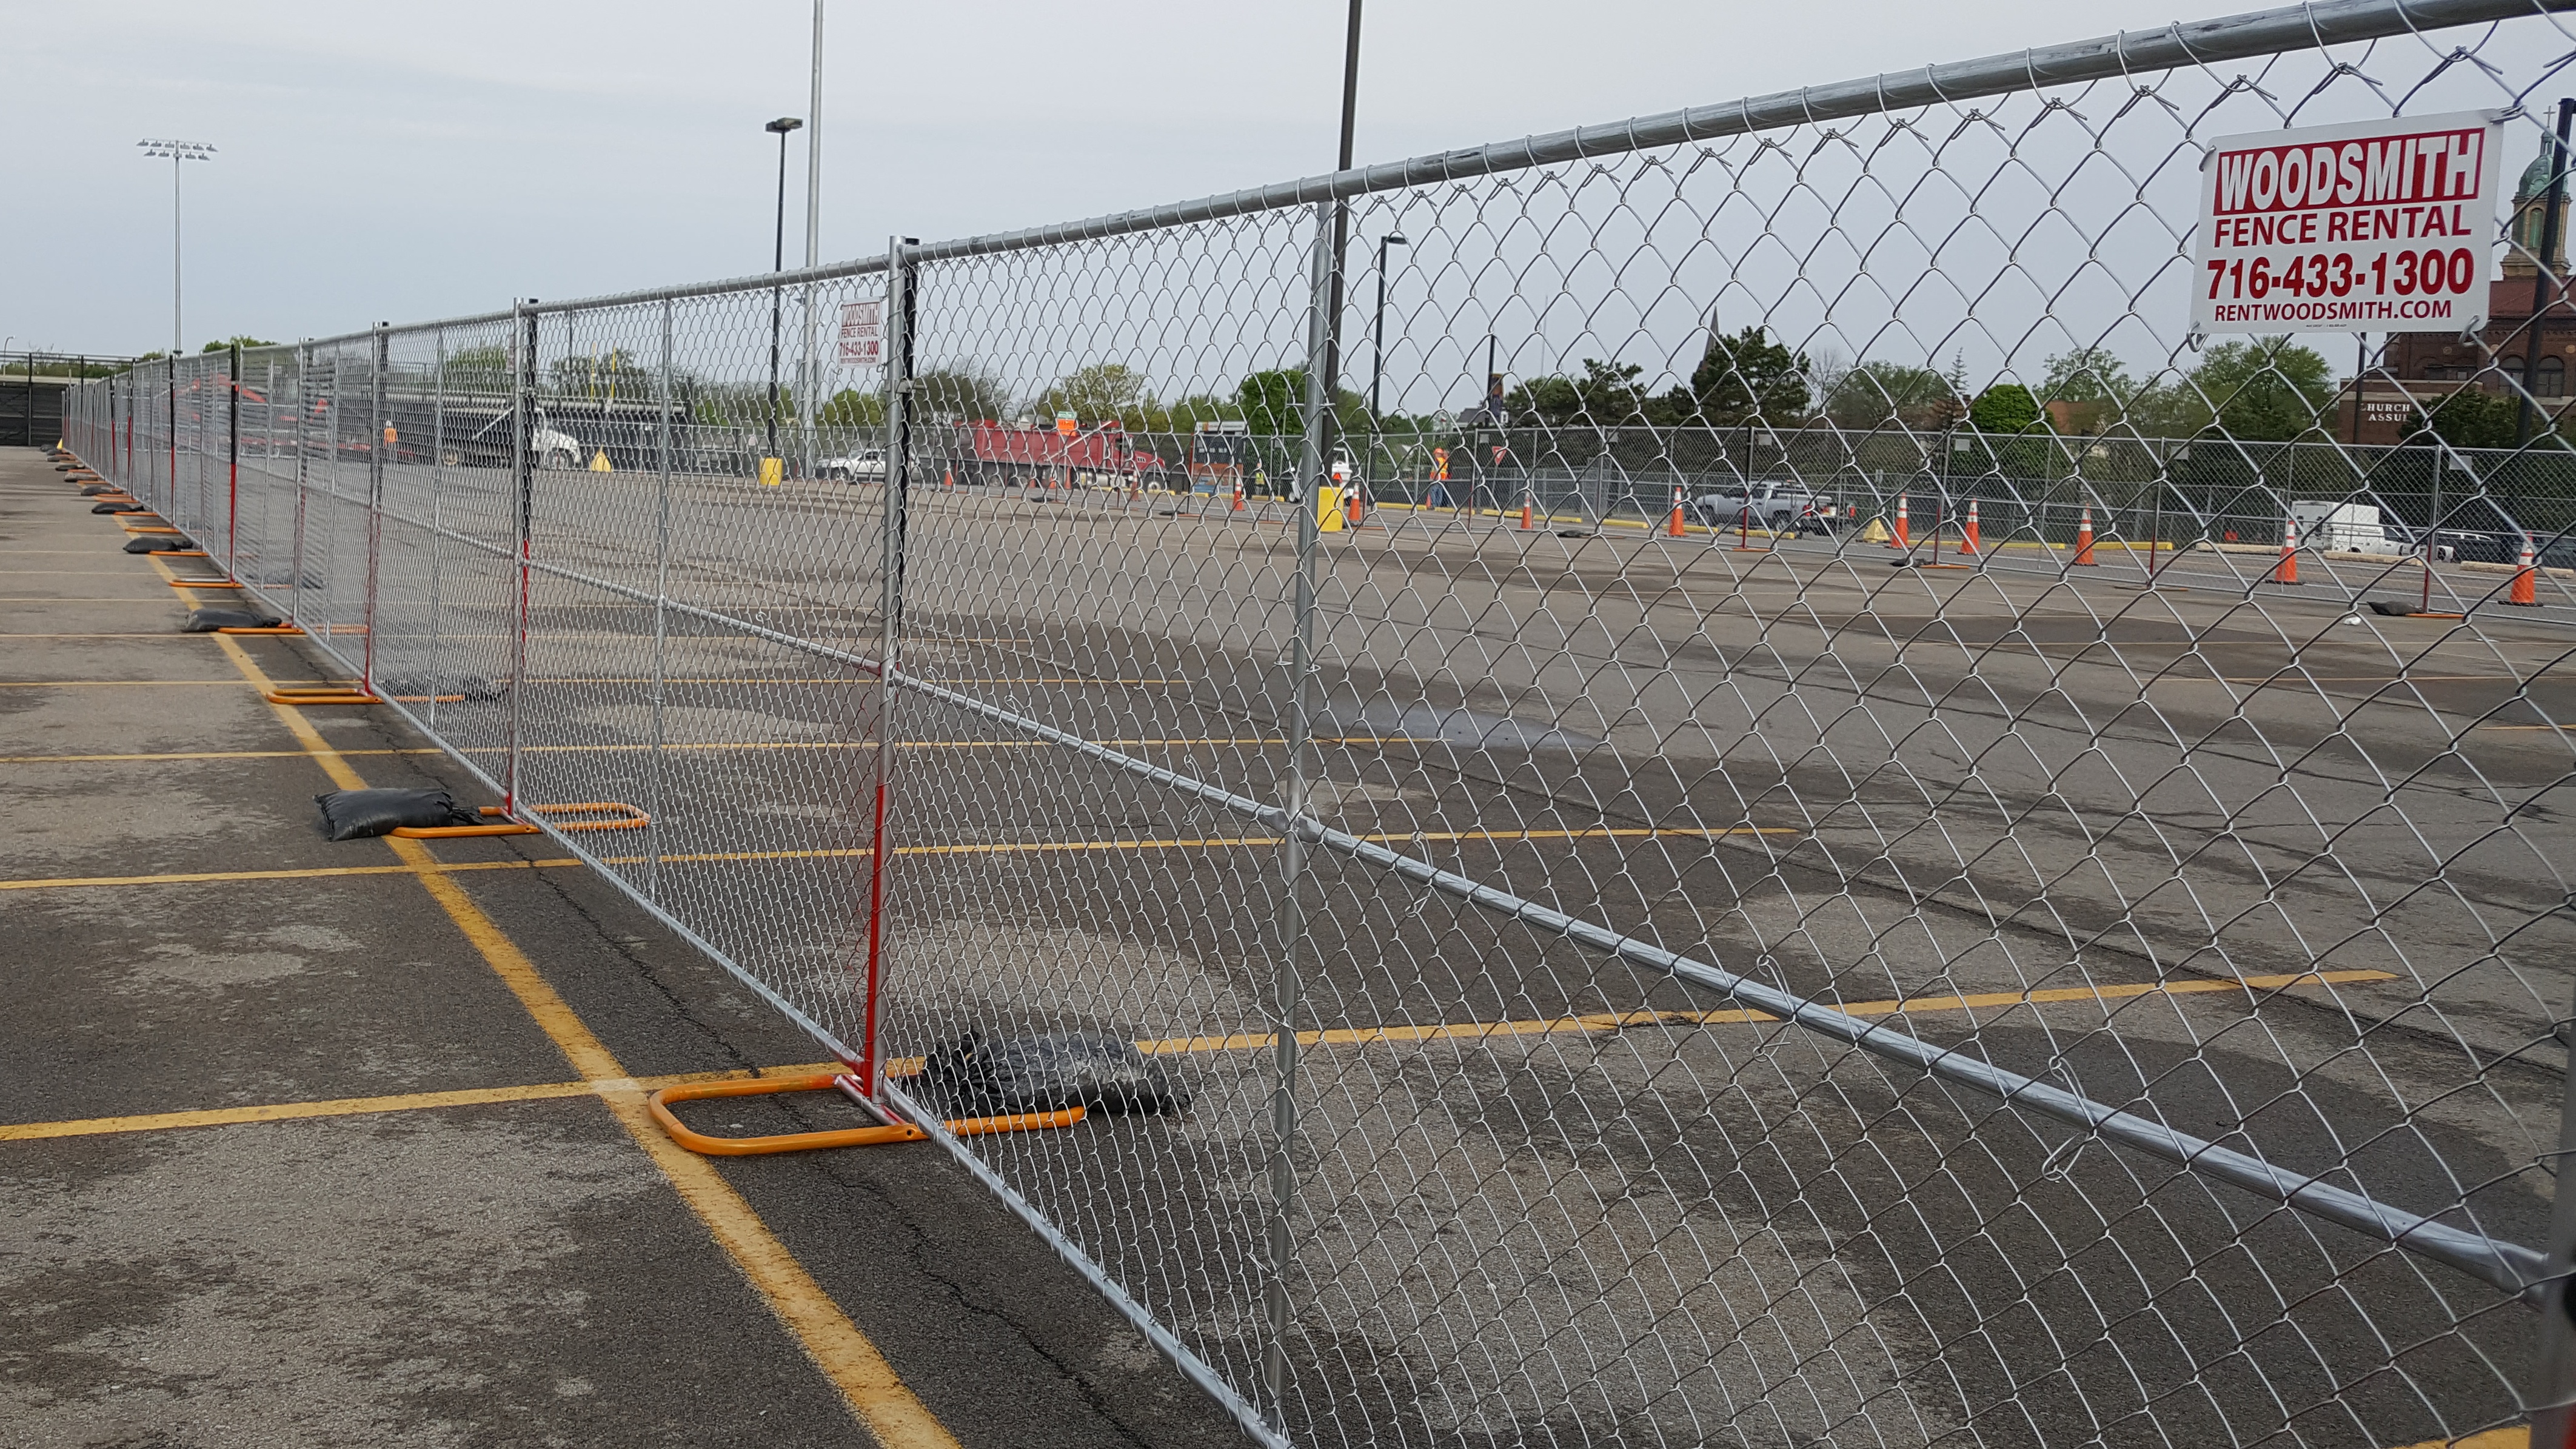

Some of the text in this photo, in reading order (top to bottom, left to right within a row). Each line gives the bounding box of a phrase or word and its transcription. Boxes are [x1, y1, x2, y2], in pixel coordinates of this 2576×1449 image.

[2220, 132, 2481, 212] WOODSMITH
[2214, 204, 2472, 248] FENCE RENTAL
[2207, 247, 2474, 300] 716-433-1300
[2215, 300, 2451, 321] RENTWOODSMITH.COM
[840, 340, 879, 356] 716-433-1300
[841, 326, 878, 338] FENCE RENTAL
